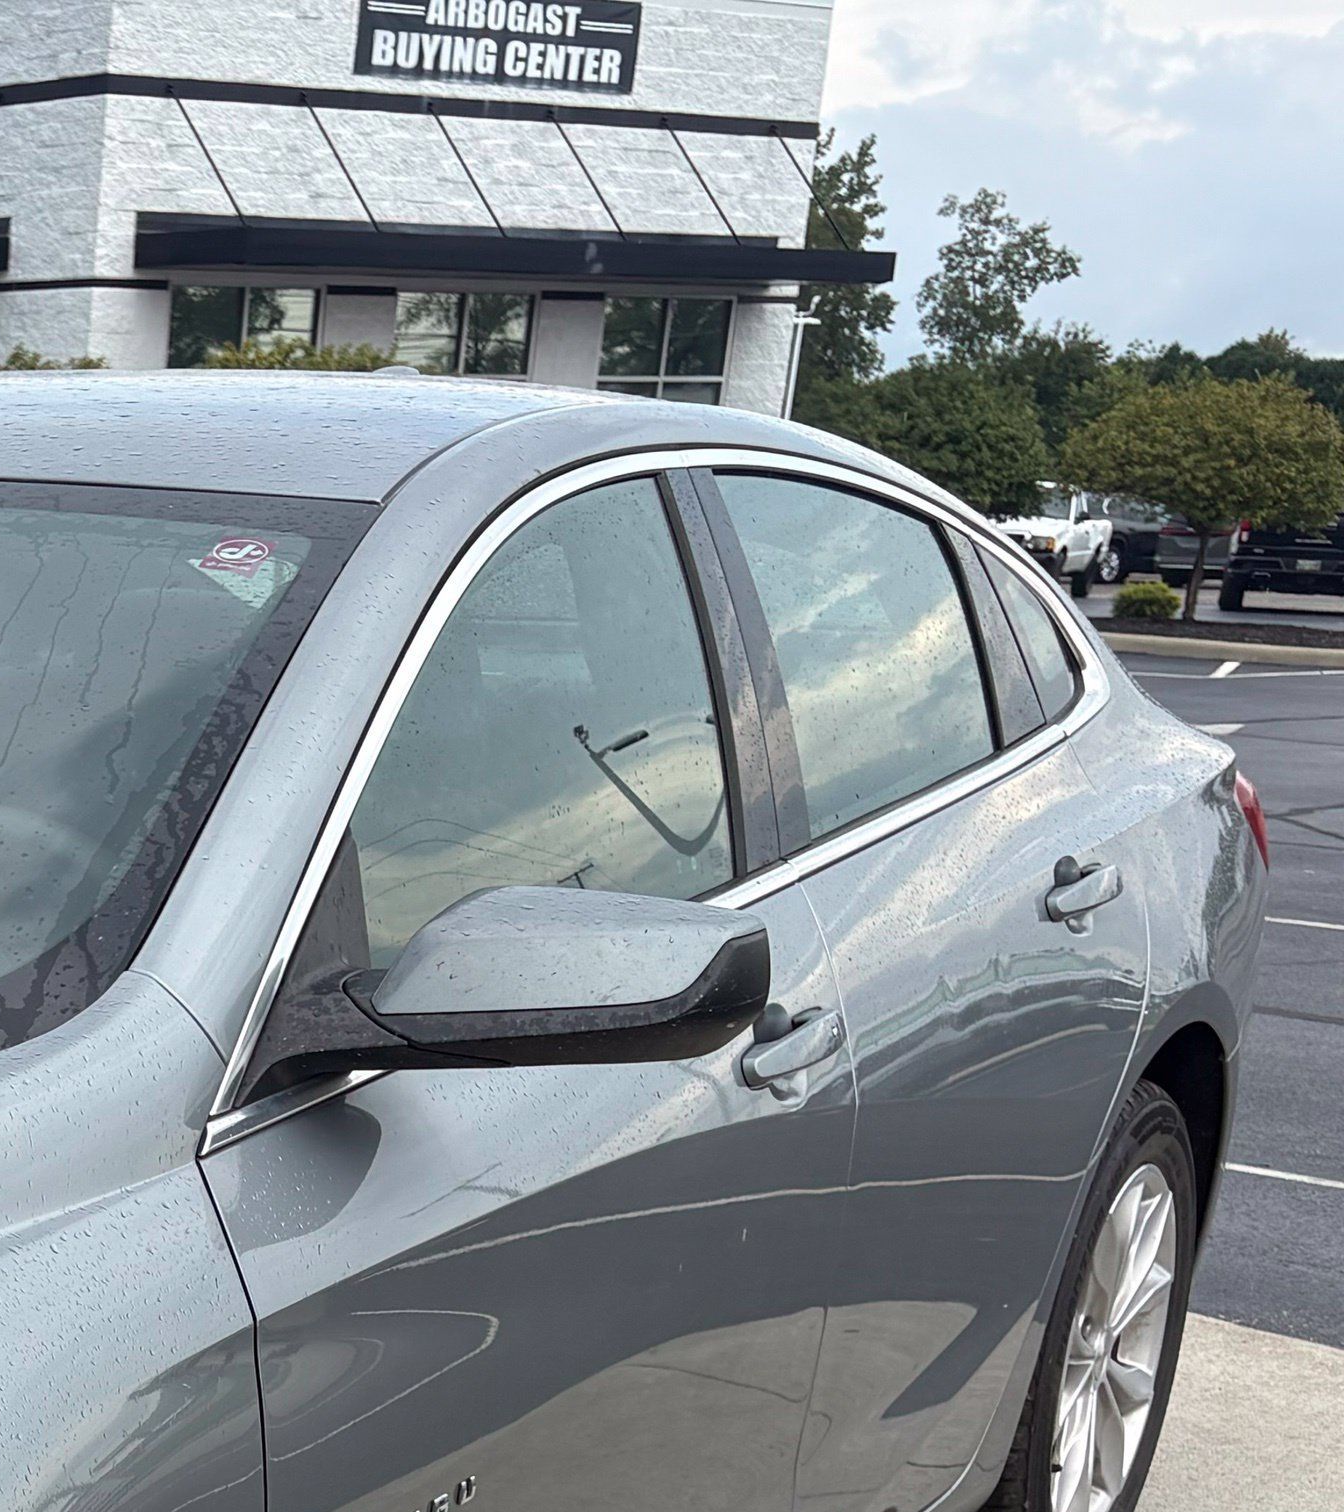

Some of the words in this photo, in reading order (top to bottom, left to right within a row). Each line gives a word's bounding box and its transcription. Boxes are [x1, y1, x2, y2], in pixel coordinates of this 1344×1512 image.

[425, 0, 582, 37] ARBOGAST
[371, 30, 497, 75] BUYING
[503, 40, 621, 84] CENTER
